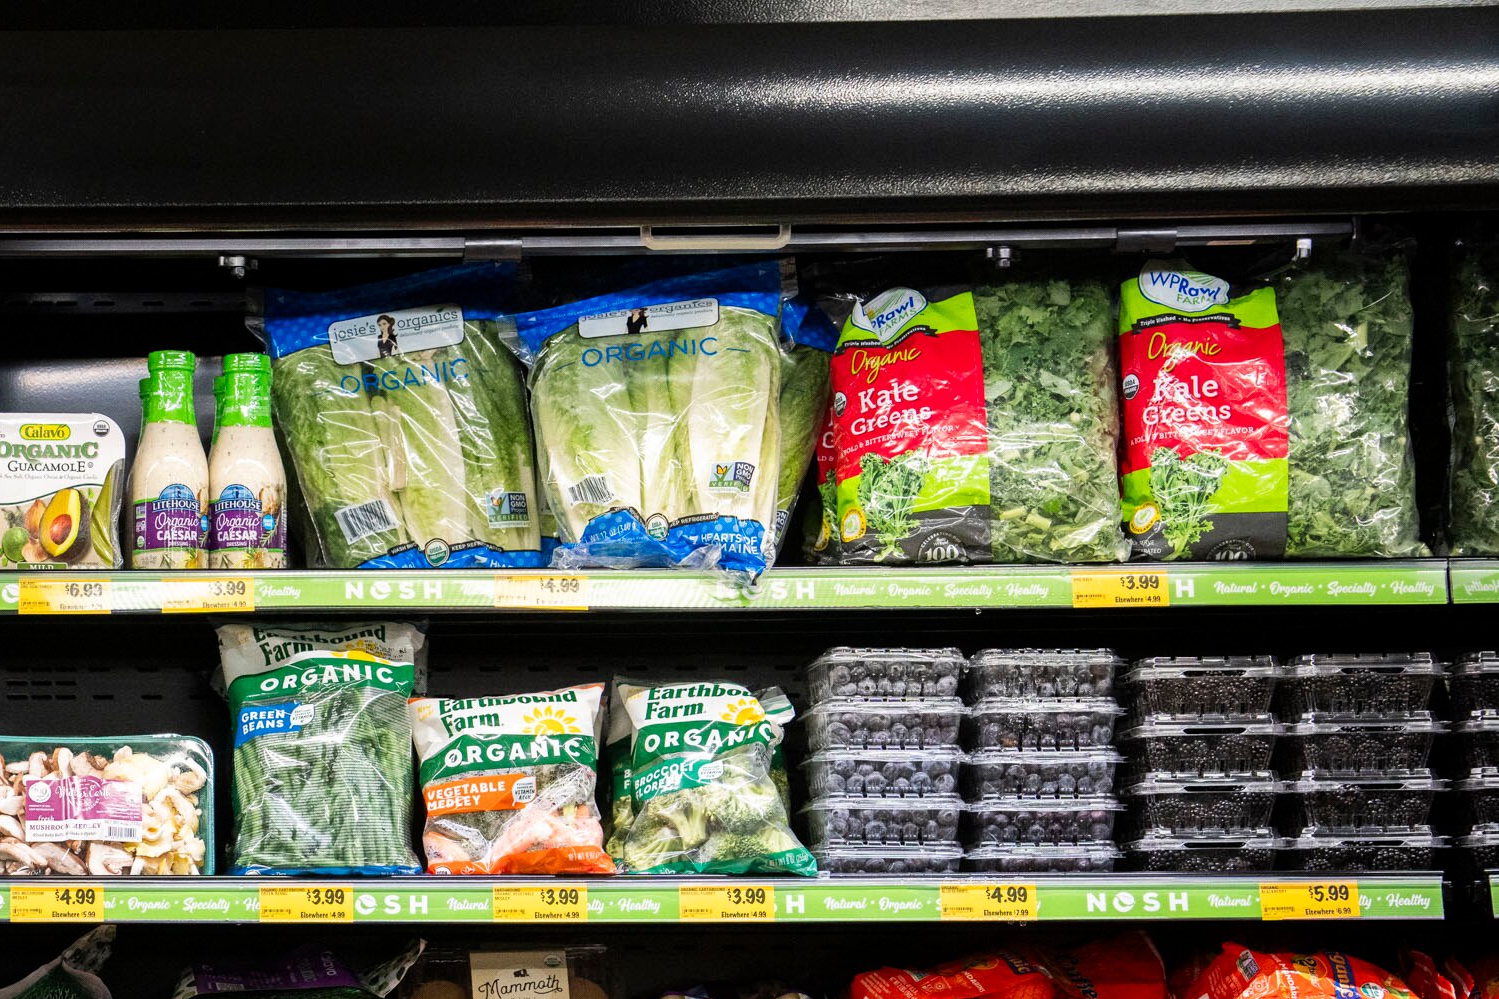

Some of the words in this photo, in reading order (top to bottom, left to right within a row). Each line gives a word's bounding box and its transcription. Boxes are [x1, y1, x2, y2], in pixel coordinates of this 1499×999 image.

[333, 318, 377, 344] josie's
[395, 309, 459, 333] organics
[879, 308, 917, 336] FARMS
[581, 337, 718, 367] ORGANIC
[1147, 332, 1222, 372] Organic
[851, 346, 923, 383] Organic
[340, 357, 469, 395] ORGANIC
[858, 382, 920, 413] Kale
[1152, 375, 1219, 402] Kale
[851, 403, 934, 436] Greens
[1142, 402, 1232, 425] Greens
[1222, 427, 1254, 436] FLAVOR
[7, 461, 86, 473] GUACAMOLE
[153, 499, 200, 511] LITEHOUSE
[155, 512, 199, 531] Organic
[156, 531, 198, 541] CAESAR
[701, 533, 742, 544] HEARTS
[743, 536, 758, 546] OF
[345, 581, 442, 599] NOSH
[1119, 574, 1160, 591] $3.99
[1215, 580, 1257, 595] Natural
[1269, 580, 1314, 597] Organic
[1327, 580, 1377, 598] Specialty
[1384, 580, 1434, 598] Healthy
[259, 641, 313, 666] Farm
[260, 665, 394, 691] ORGANIC
[241, 709, 285, 723] GREEN
[645, 701, 704, 720] Farm
[242, 719, 285, 735] BEANS
[440, 711, 501, 738] Farm
[644, 721, 772, 753] ORGANIC
[445, 738, 581, 768] ORGANIC
[427, 781, 505, 800] VEGETABLE
[427, 795, 481, 812] MEDLEY
[55, 889, 95, 905] $4.99
[306, 888, 345, 905] $3.99
[726, 888, 766, 904] $3.99
[985, 886, 1027, 903] $4.99
[1086, 892, 1188, 911] NOSH
[1308, 884, 1348, 901] $5.99
[128, 896, 171, 912] Organic
[182, 896, 230, 913] Specialty
[617, 896, 661, 914] Healthy
[534, 911, 562, 919] Elsewhere
